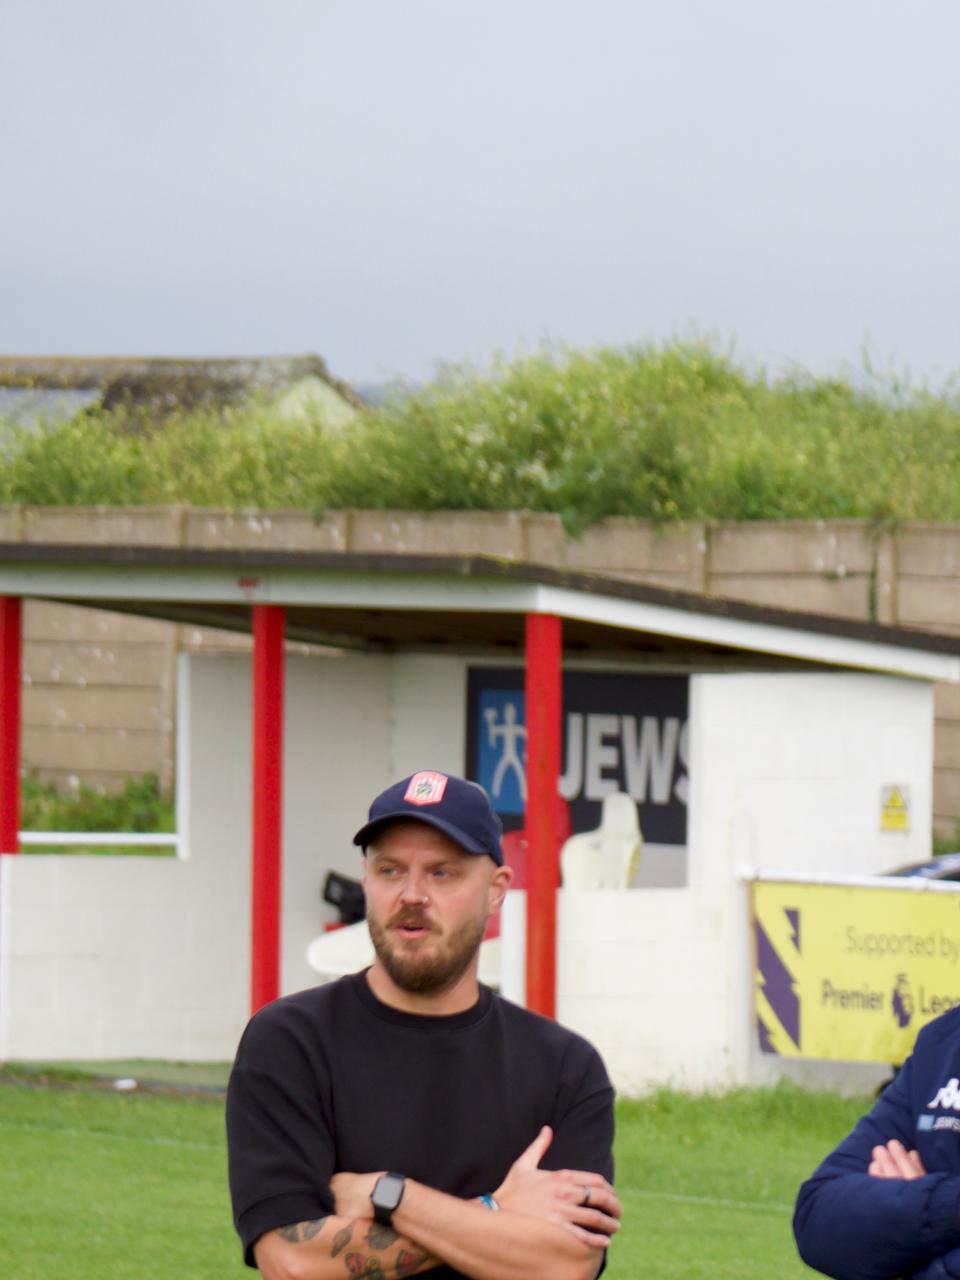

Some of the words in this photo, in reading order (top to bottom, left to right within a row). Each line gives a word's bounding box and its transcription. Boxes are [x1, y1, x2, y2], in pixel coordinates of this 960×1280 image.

[845, 924, 936, 959] Supported
[939, 928, 960, 967] by
[821, 979, 884, 1012] Premier
